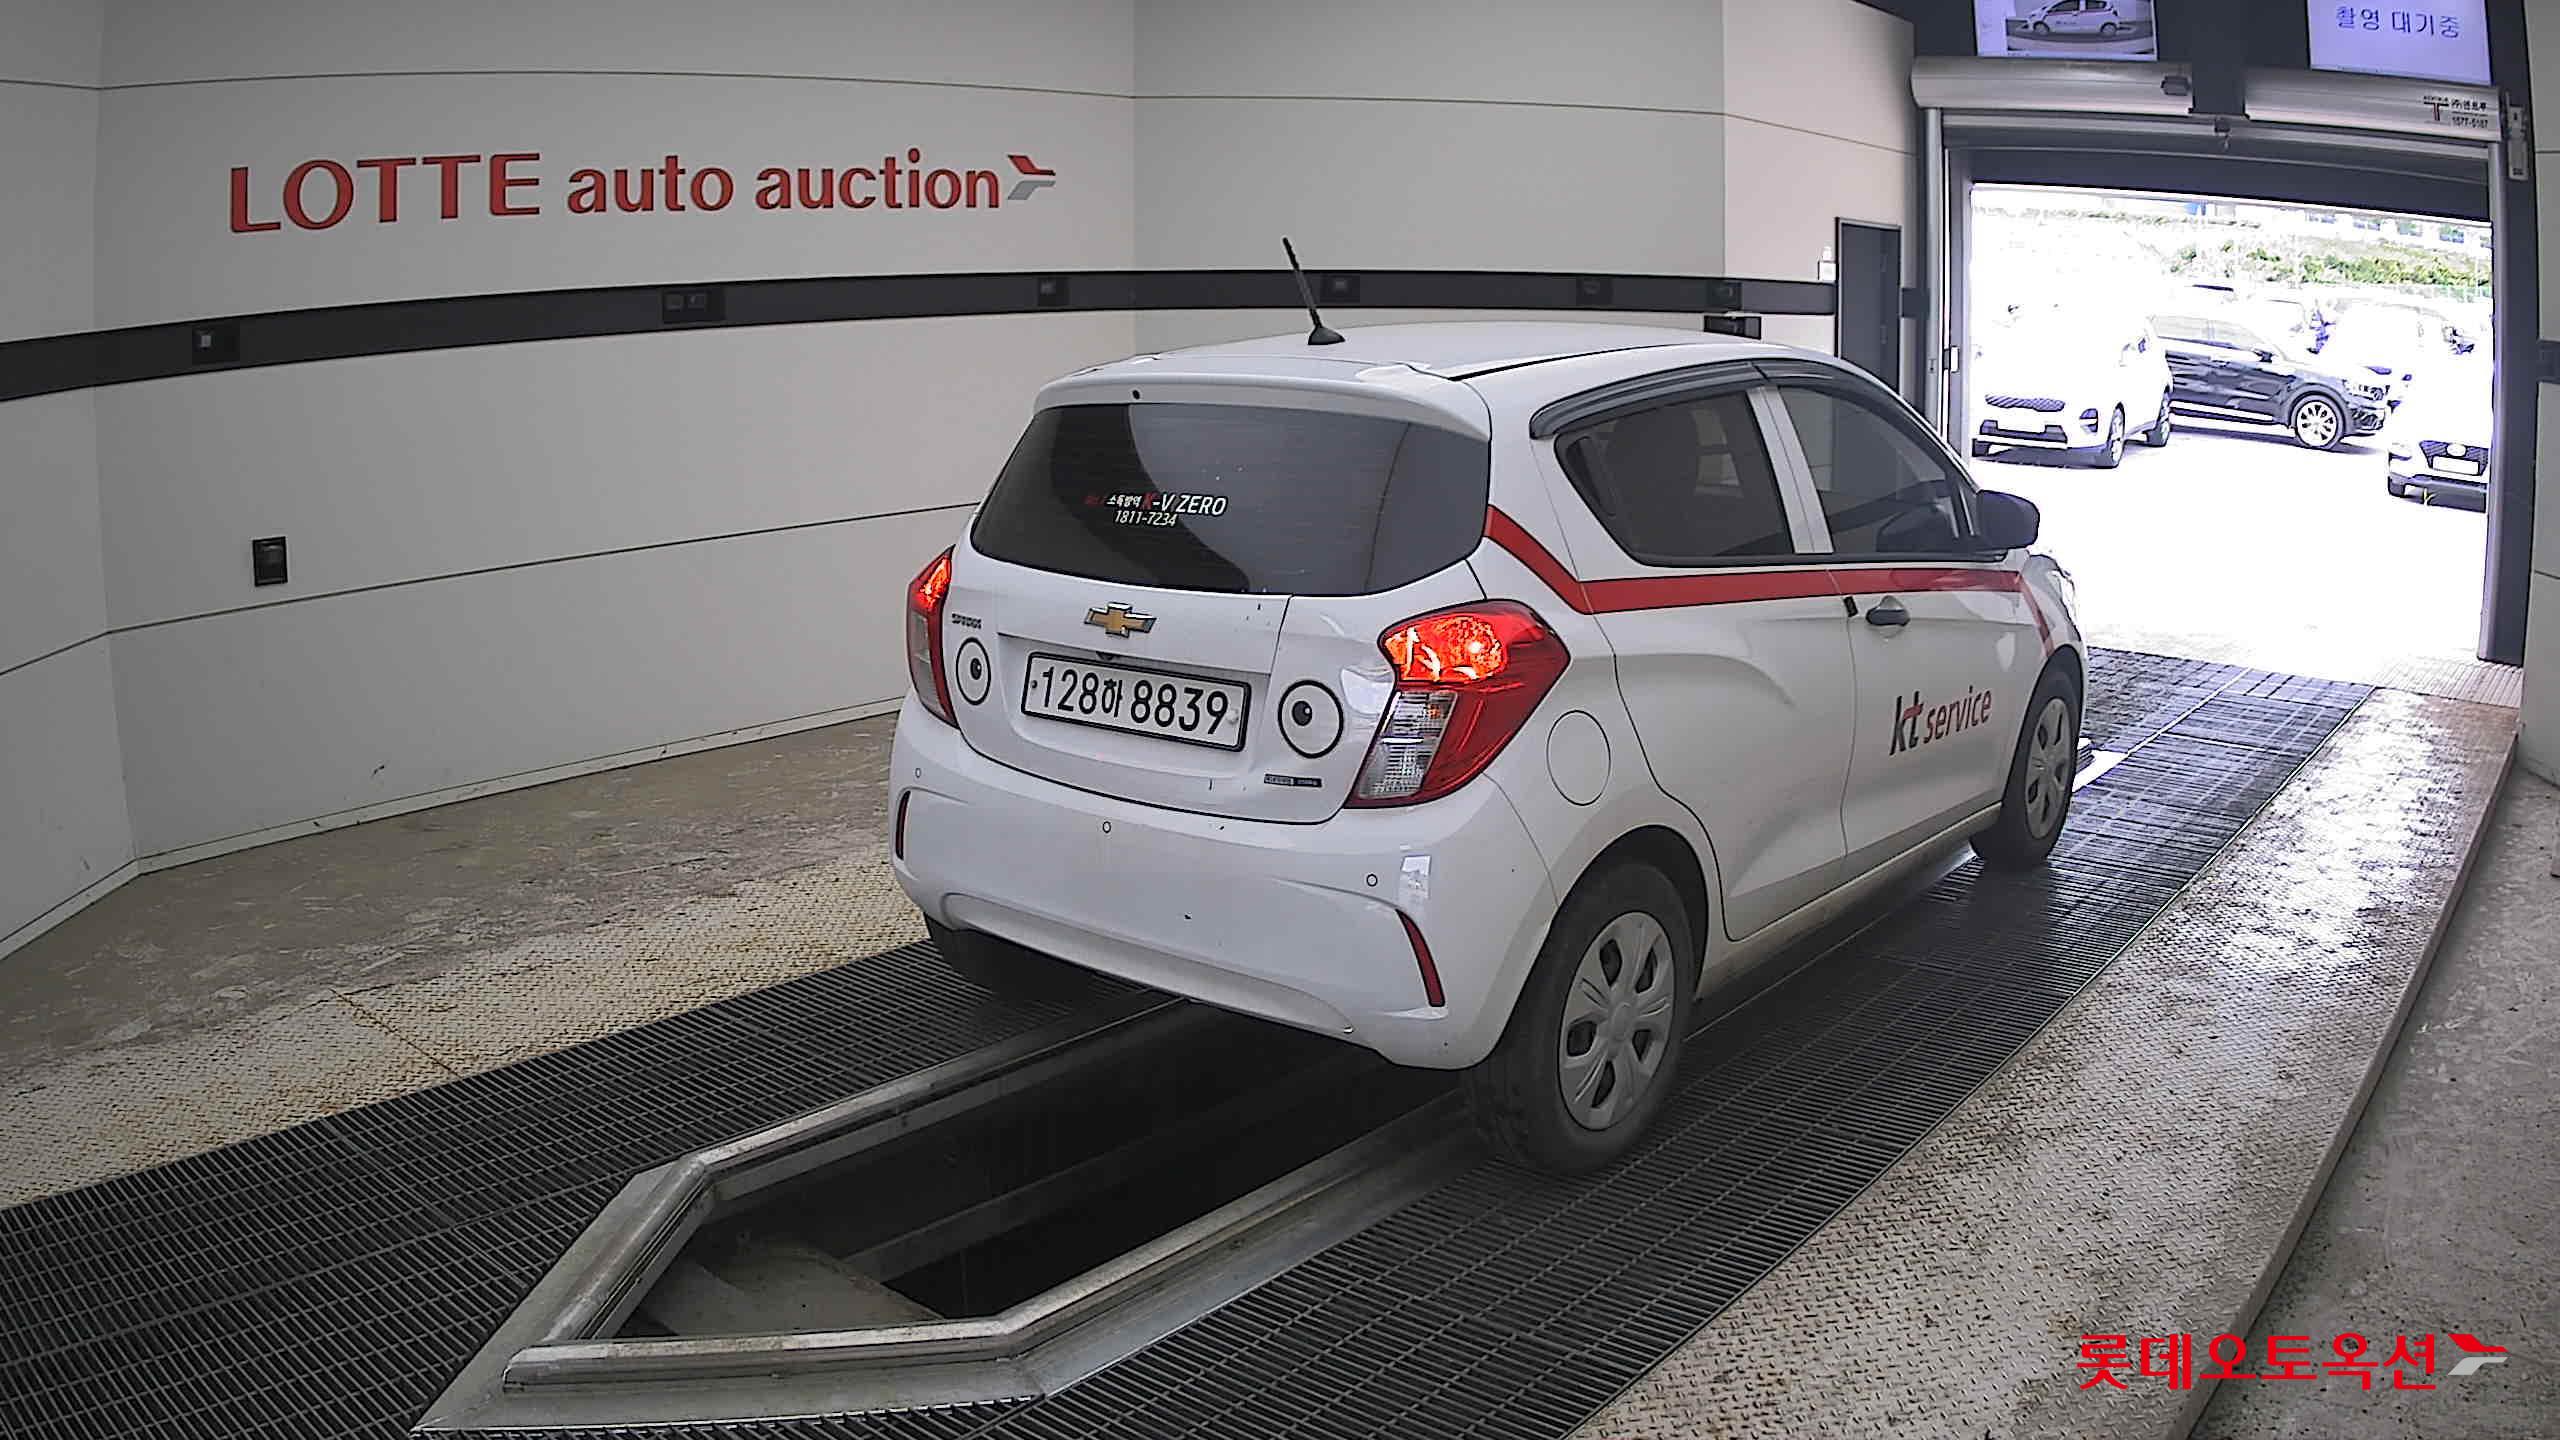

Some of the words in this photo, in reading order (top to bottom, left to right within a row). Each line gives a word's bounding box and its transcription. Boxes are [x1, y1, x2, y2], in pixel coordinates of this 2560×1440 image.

[2337, 6, 2380, 32] 촬영
[2391, 10, 2460, 39] 대기중
[231, 152, 541, 233] LOTTE
[567, 154, 735, 213] auto
[754, 147, 1001, 210] auction
[1114, 509, 1178, 527] 1811-7234
[1175, 493, 1228, 517] ZERO
[1130, 679, 1230, 735] 8839
[1889, 690, 1925, 756] kt
[1923, 684, 1993, 744] service
